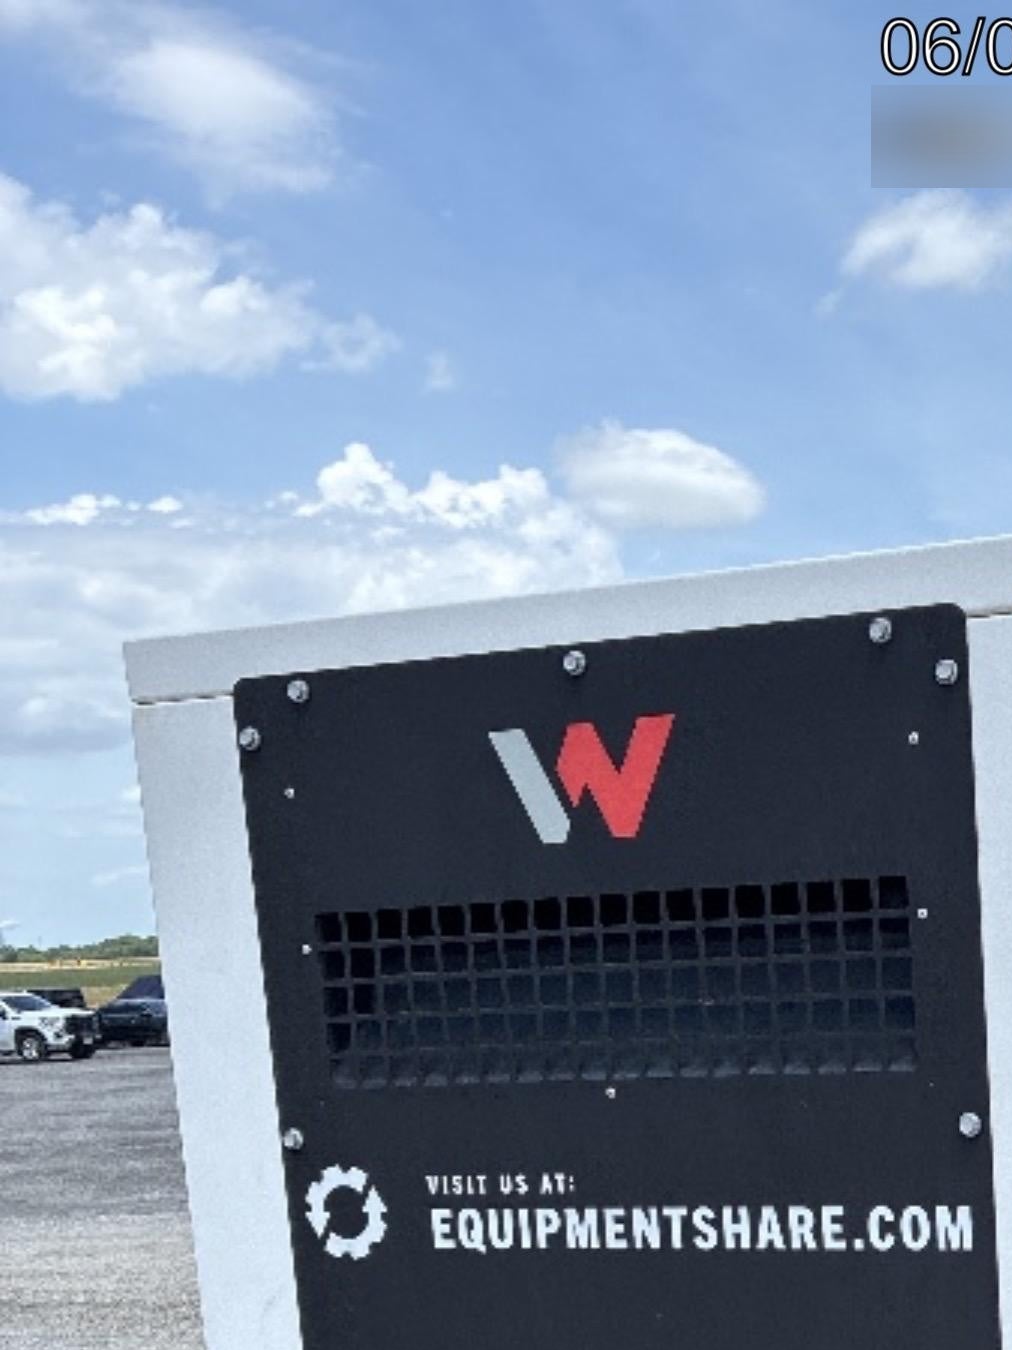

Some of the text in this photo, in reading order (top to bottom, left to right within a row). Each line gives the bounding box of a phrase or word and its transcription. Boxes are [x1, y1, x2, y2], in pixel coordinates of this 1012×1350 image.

[424, 1172, 575, 1196] VISIT US AT:
[430, 1204, 975, 1255] EQUIPMENTSHARE.COM
